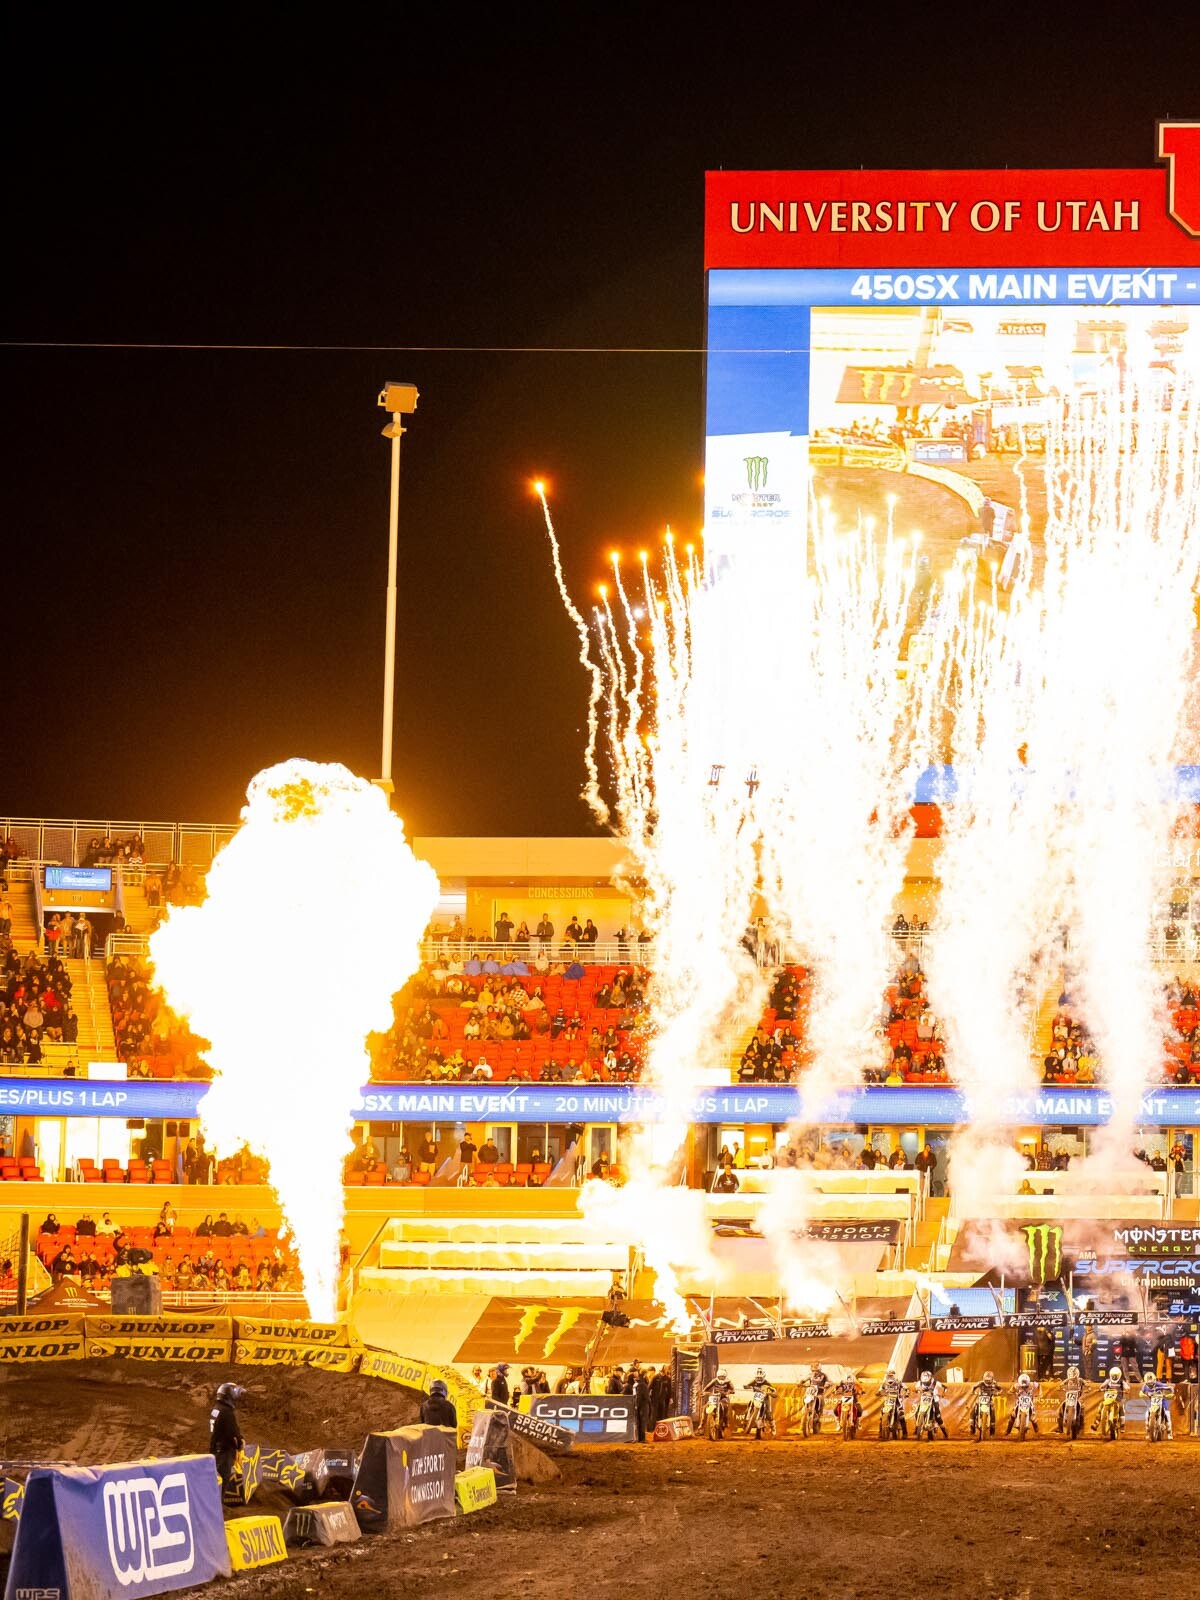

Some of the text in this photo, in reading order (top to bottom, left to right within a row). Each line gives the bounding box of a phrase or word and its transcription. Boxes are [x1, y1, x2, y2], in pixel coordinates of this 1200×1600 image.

[730, 200, 1140, 233] UNIVERSITY OF UTAH
[850, 275, 960, 301] 450SX
[969, 274, 1058, 300] MAIN
[1067, 274, 1178, 300] EVENT
[528, 887, 594, 898] CONCESSIONS
[79, 1092, 87, 1106] 1
[92, 1092, 128, 1107] LAP
[399, 1095, 454, 1112] MAIN
[460, 1096, 529, 1112] EVENT
[555, 1097, 579, 1112] 20
[722, 1098, 729, 1112] 1
[734, 1098, 769, 1113] LAP
[1035, 1099, 1092, 1115] MAIN
[822, 1226, 891, 1234] SPORTS
[1079, 1252, 1097, 1260] AMA
[119, 1322, 214, 1334] DUNLOP
[259, 1325, 336, 1340] DUNLOP
[112, 1346, 224, 1360] DUNLOP
[253, 1347, 347, 1364] DUNLOP
[371, 1359, 423, 1382] DUNLOP
[536, 1404, 629, 1419] GoPro
[515, 1414, 559, 1440] SPECIAL
[424, 1453, 445, 1475] SPORTS
[411, 1480, 446, 1505] COMMISSION
[103, 1473, 195, 1586] WPS
[239, 1524, 284, 1564] SUZUKI
[16, 1588, 60, 1600] WPS
